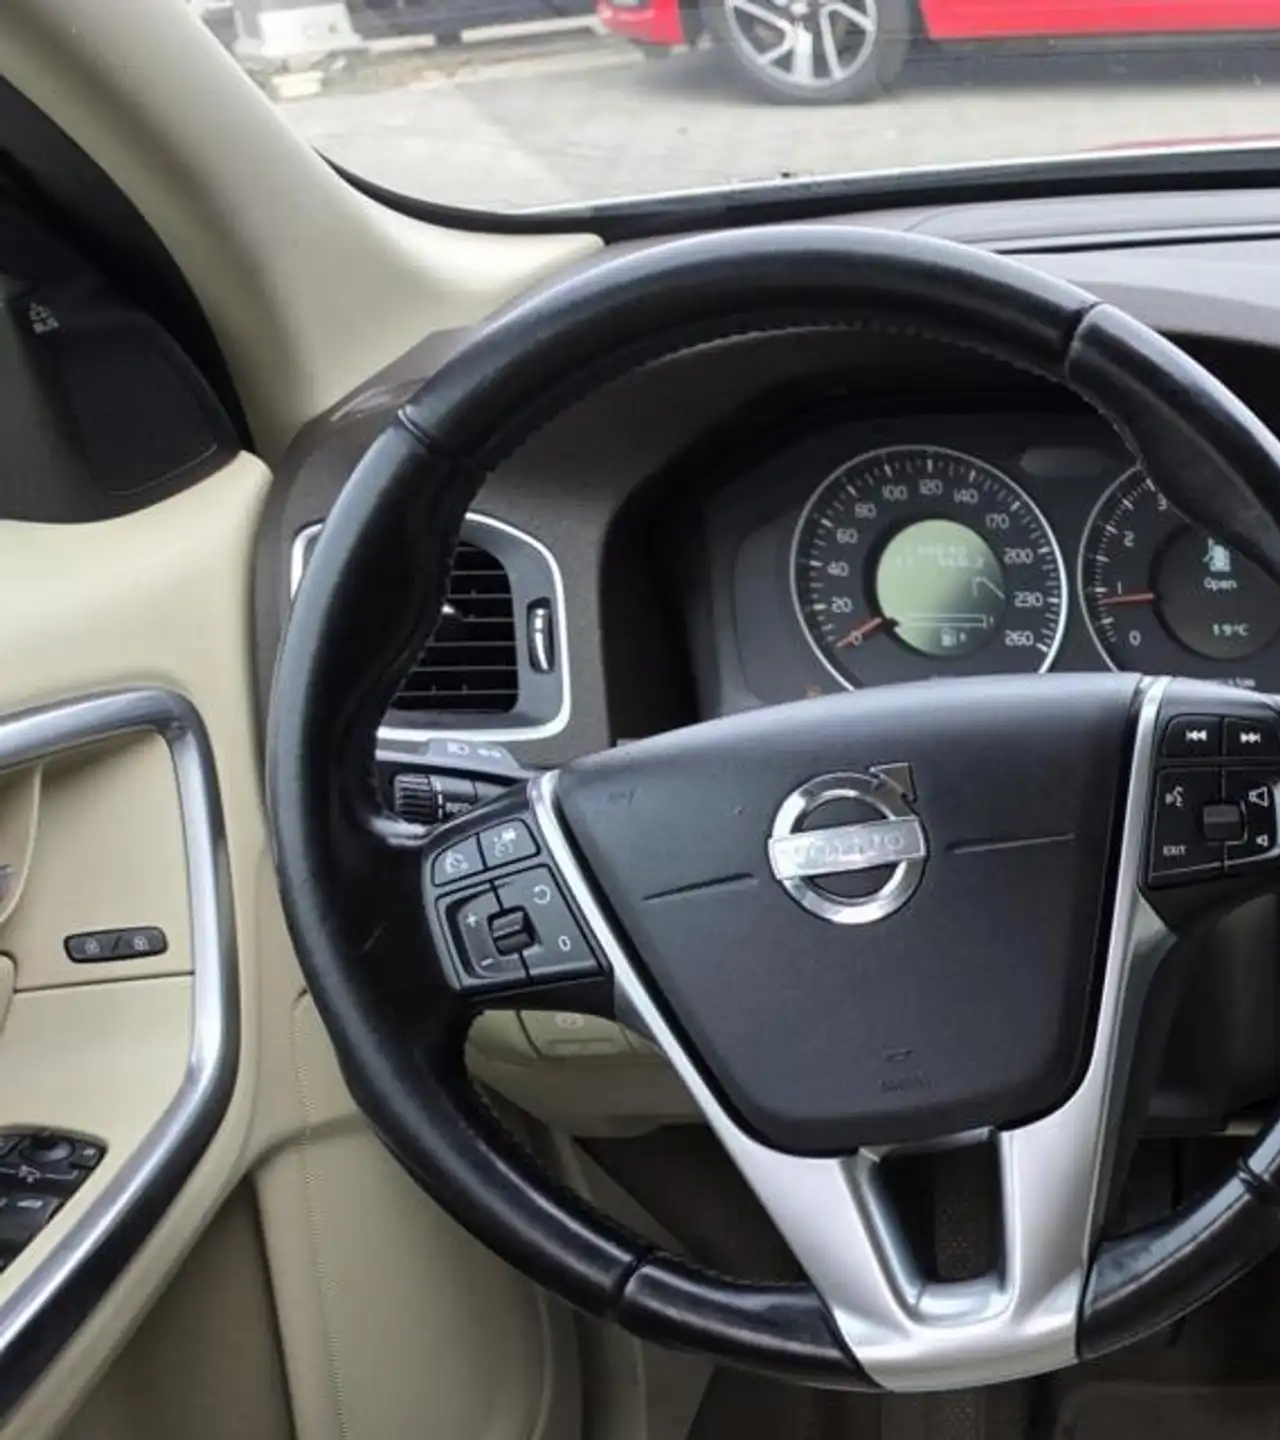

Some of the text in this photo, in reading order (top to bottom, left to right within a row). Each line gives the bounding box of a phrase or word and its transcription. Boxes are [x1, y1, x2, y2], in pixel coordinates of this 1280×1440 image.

[881, 485, 908, 500] 100
[919, 479, 943, 495] 120
[953, 487, 979, 503] 140
[854, 503, 877, 519] 80
[985, 513, 1010, 530] 170
[836, 528, 859, 544] 60
[1123, 530, 1136, 548] 2
[1003, 549, 1034, 564] 200
[827, 561, 849, 577] 40
[1203, 576, 1238, 593] Open
[830, 597, 852, 613] 20
[1013, 592, 1043, 607] 230
[1004, 629, 1034, 646] 260
[1128, 629, 1142, 647] 0
[1161, 845, 1187, 857] EXIT
